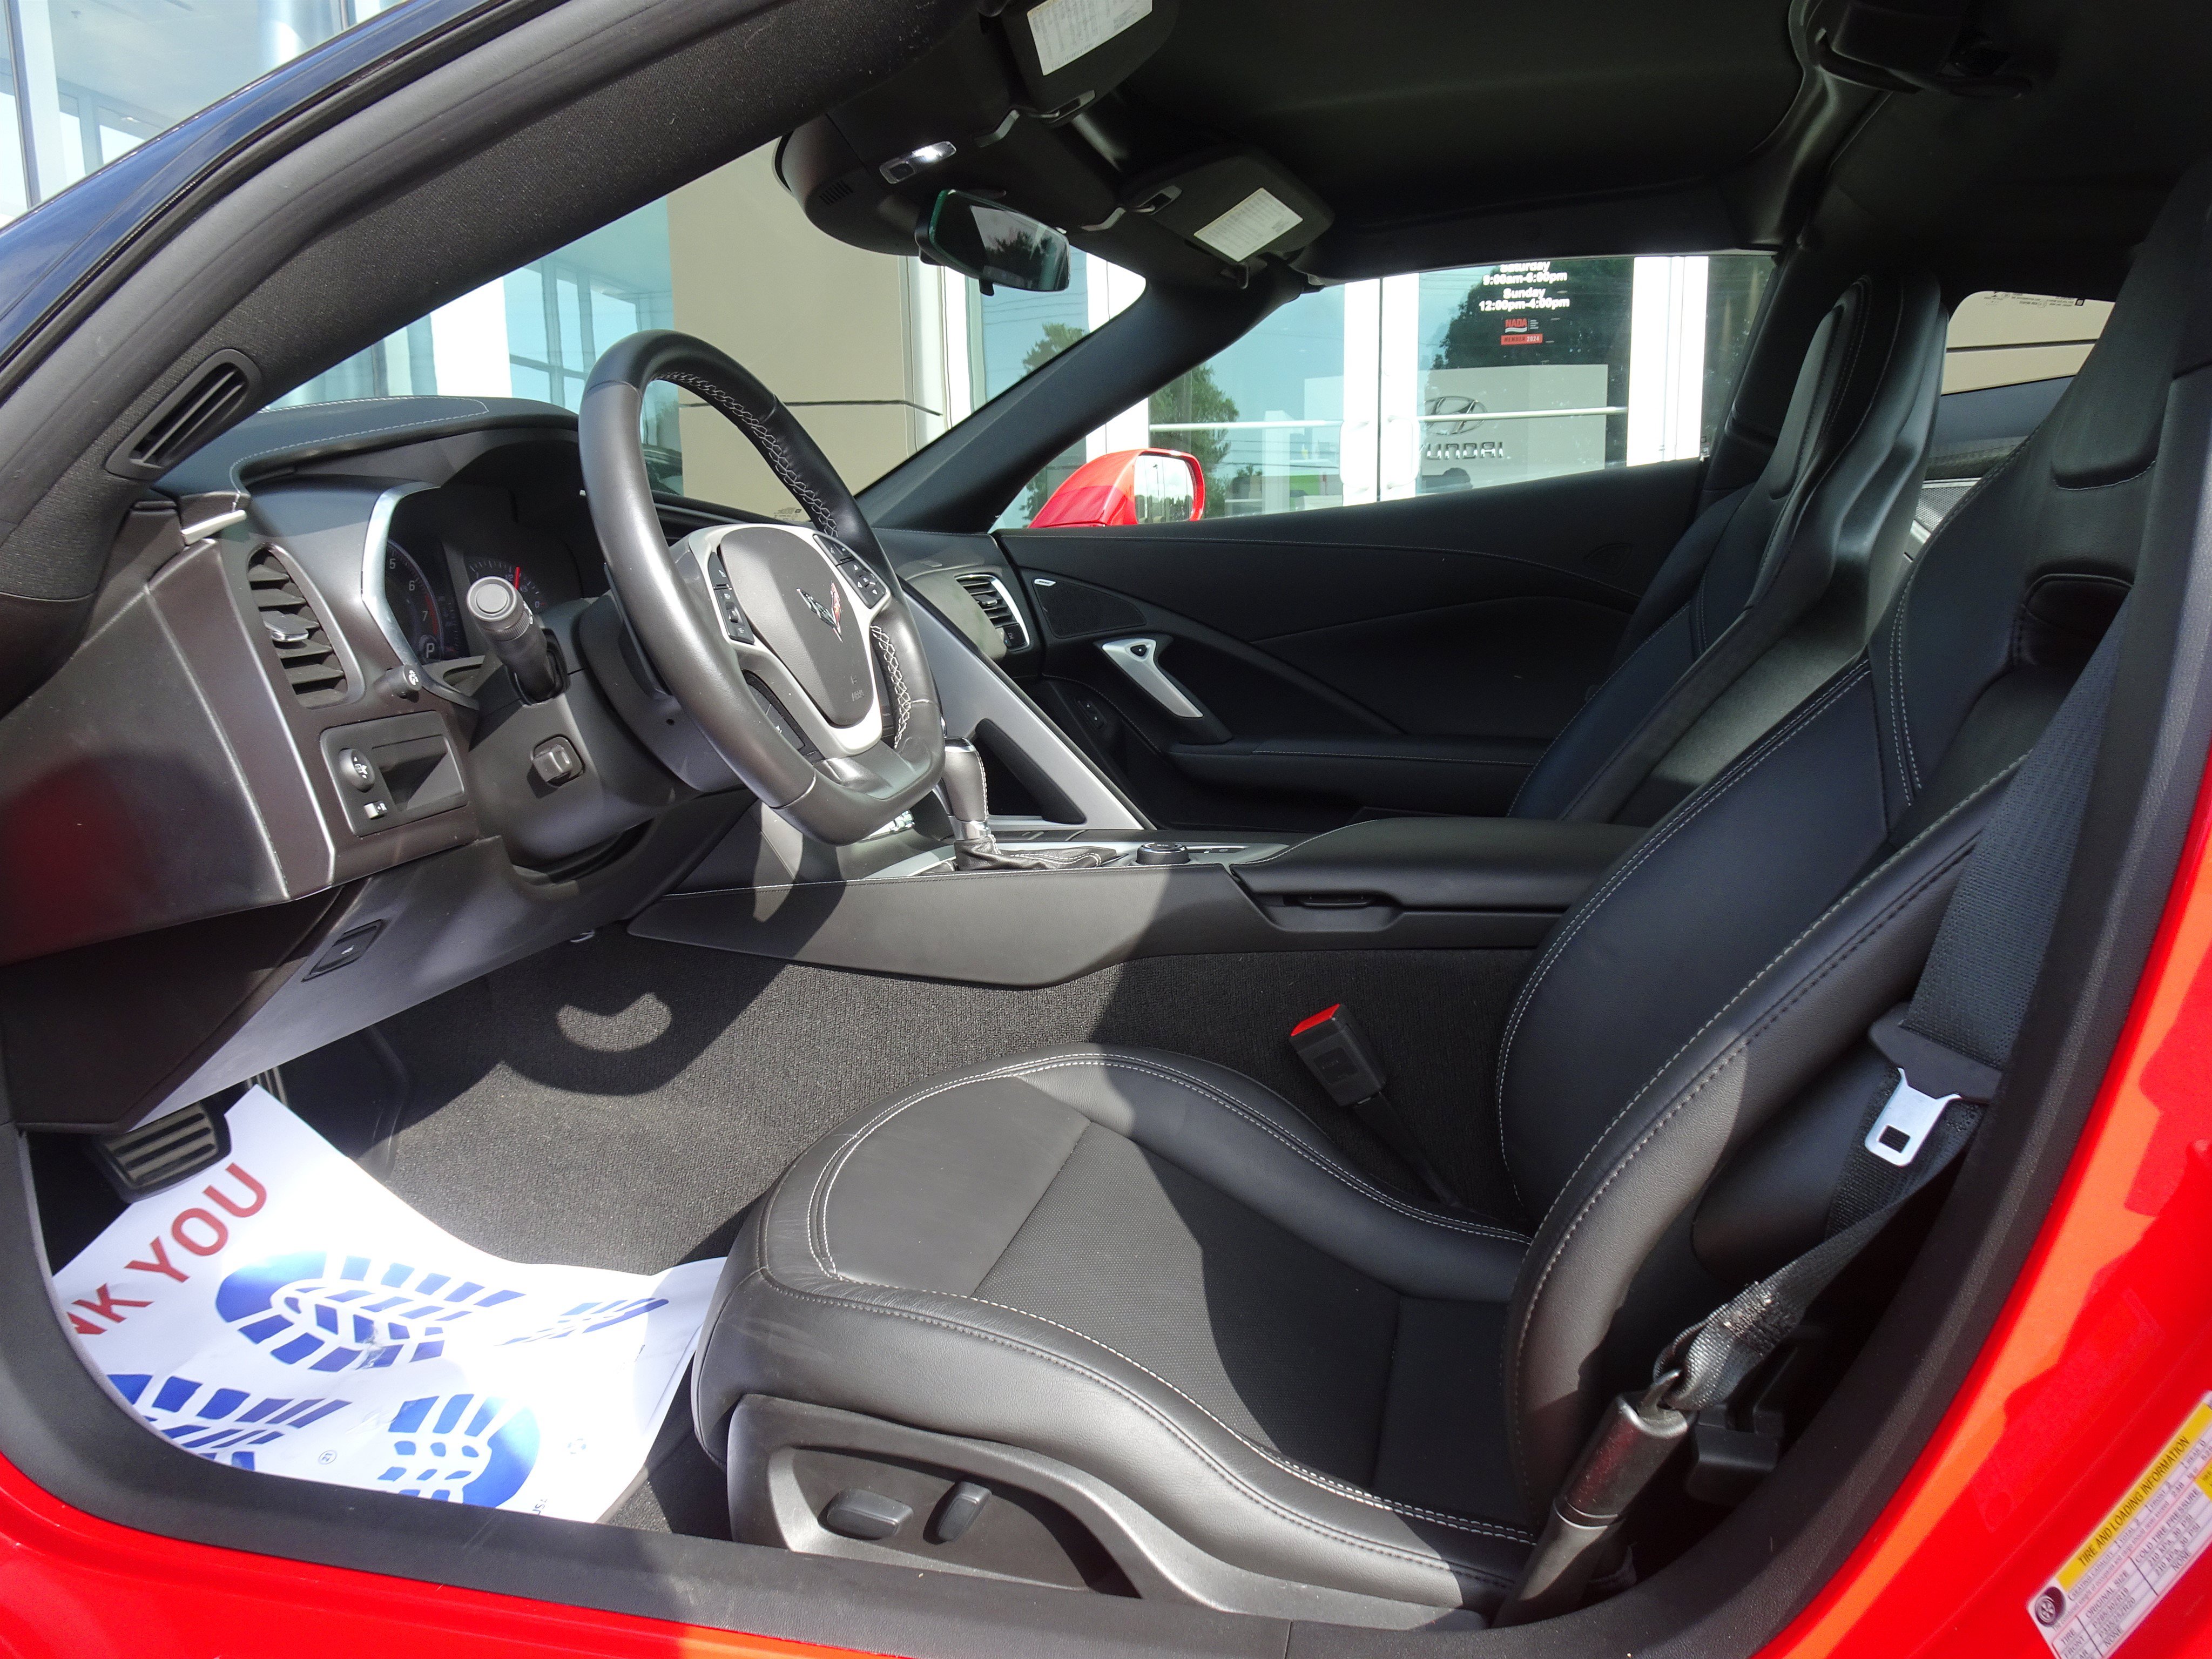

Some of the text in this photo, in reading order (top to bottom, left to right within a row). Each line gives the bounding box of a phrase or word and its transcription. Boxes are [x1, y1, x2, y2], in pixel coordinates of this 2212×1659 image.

[1483, 272, 1567, 285] 9:00am-6:00pm
[1503, 287, 1546, 299] Sunday
[1479, 298, 1570, 312] 12:00pm-4:00pm
[1506, 318, 1527, 328] NADA
[389, 558, 396, 569] 5
[409, 581, 415, 591] 6
[422, 611, 428, 621] 7
[426, 643, 435, 658] P
[124, 1162, 267, 1283] YOU
[2078, 1435, 2190, 1567] TIRE AND LOADING INFORMATION
[2134, 1487, 2200, 1563] COLD TIRE PRESSURE
[2147, 1552, 2160, 1567] 210
[2172, 1527, 2181, 1538] 30
[2181, 1513, 2193, 1528] PSI
[2154, 1561, 2167, 1576] 210
[2188, 1522, 2200, 1537] PSI
[2171, 1548, 2191, 1572] NONE
[2085, 1569, 2129, 1619] ORIGINAL SIZE
[2060, 1627, 2076, 1645] TIRE
[2103, 1626, 2123, 1648] NONE
[2064, 1634, 2086, 1659] FRONT
